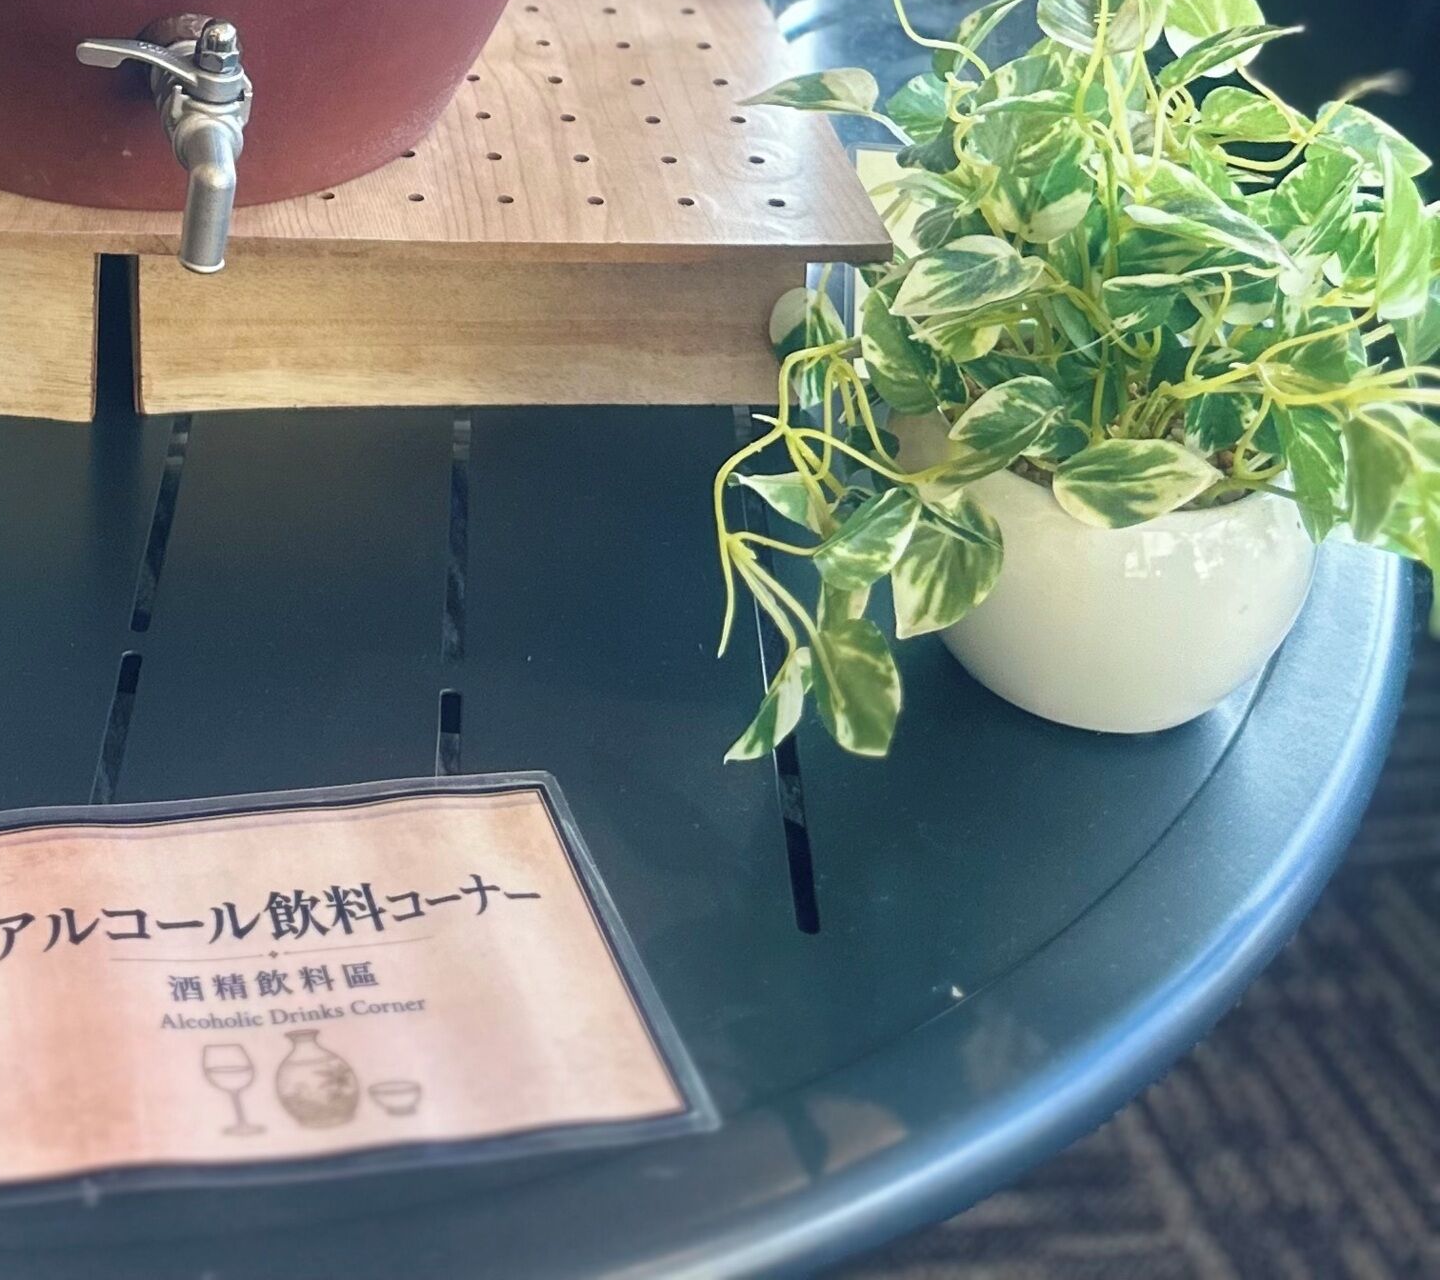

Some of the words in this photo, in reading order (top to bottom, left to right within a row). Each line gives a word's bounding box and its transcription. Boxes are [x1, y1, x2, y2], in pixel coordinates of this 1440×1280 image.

[167, 961, 379, 1003] 酒精飲料區
[160, 1007, 264, 1031] Alcoholic
[271, 1002, 345, 1026] Drinks
[350, 996, 426, 1018] Corner
